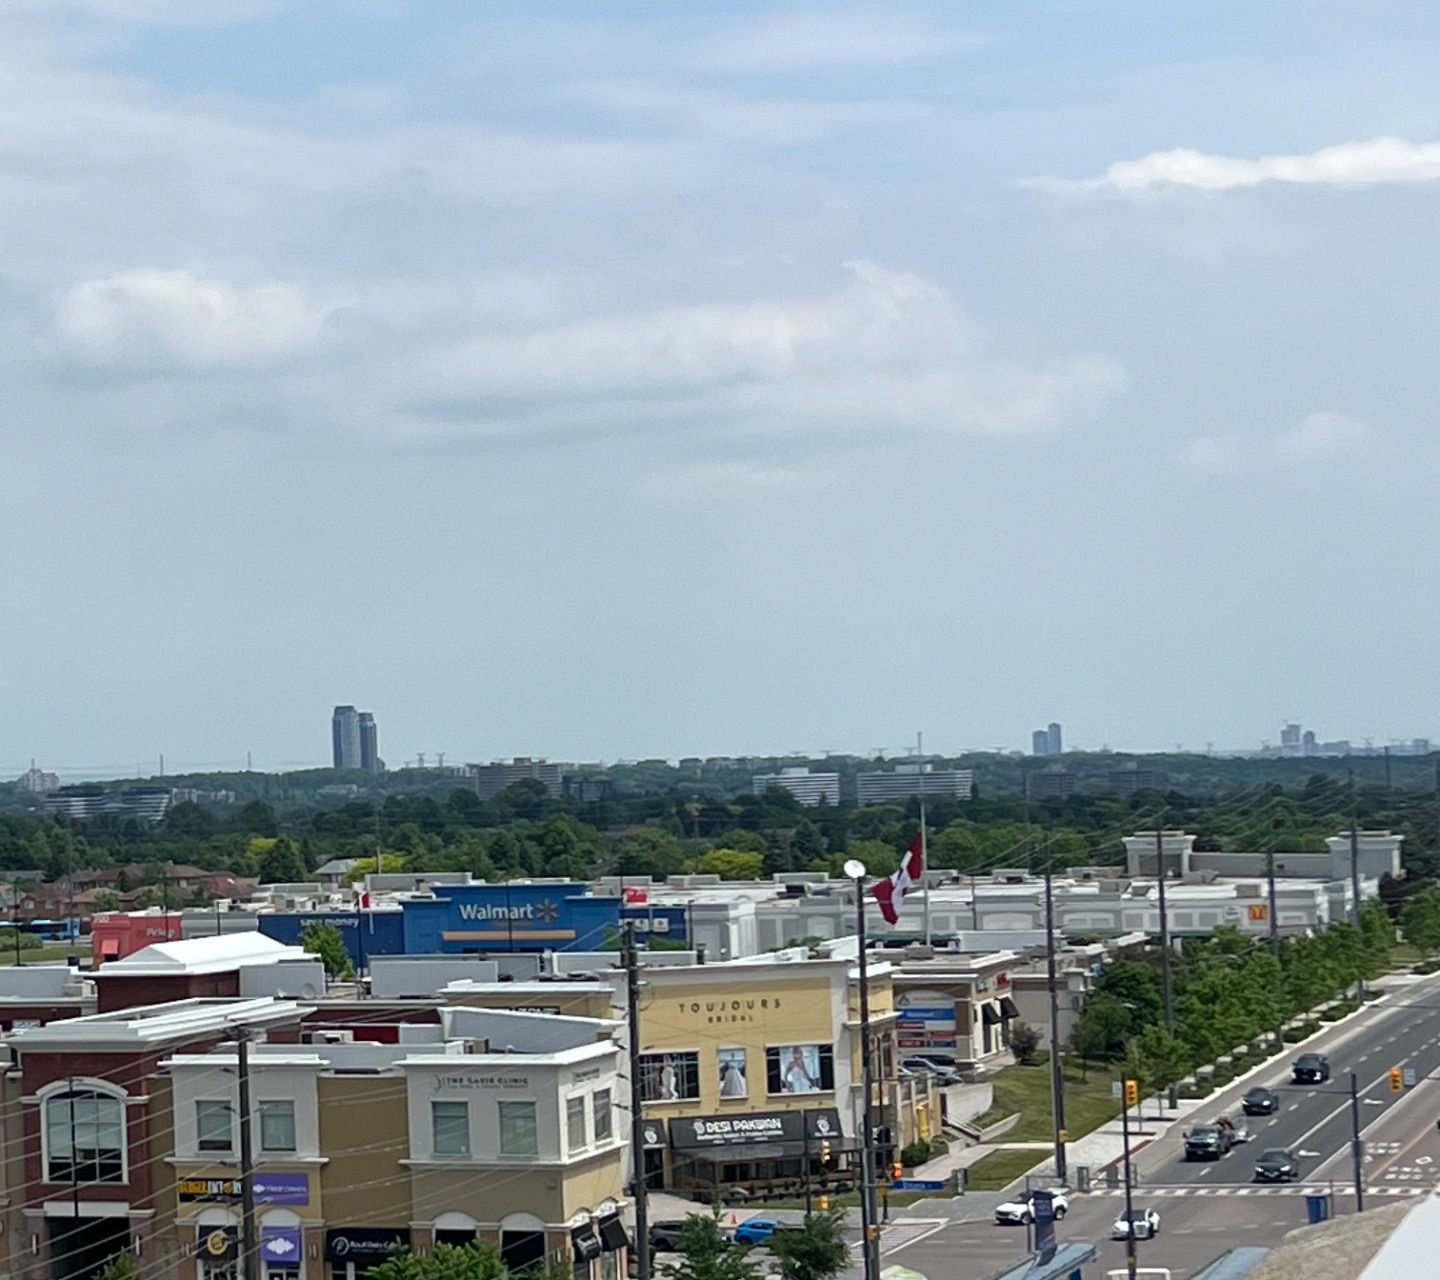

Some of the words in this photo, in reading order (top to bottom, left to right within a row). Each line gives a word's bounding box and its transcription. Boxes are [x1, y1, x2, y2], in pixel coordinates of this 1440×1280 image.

[459, 903, 534, 920] Walmart
[678, 998, 781, 1013] TOUJOURS
[705, 1121, 731, 1133] DESI
